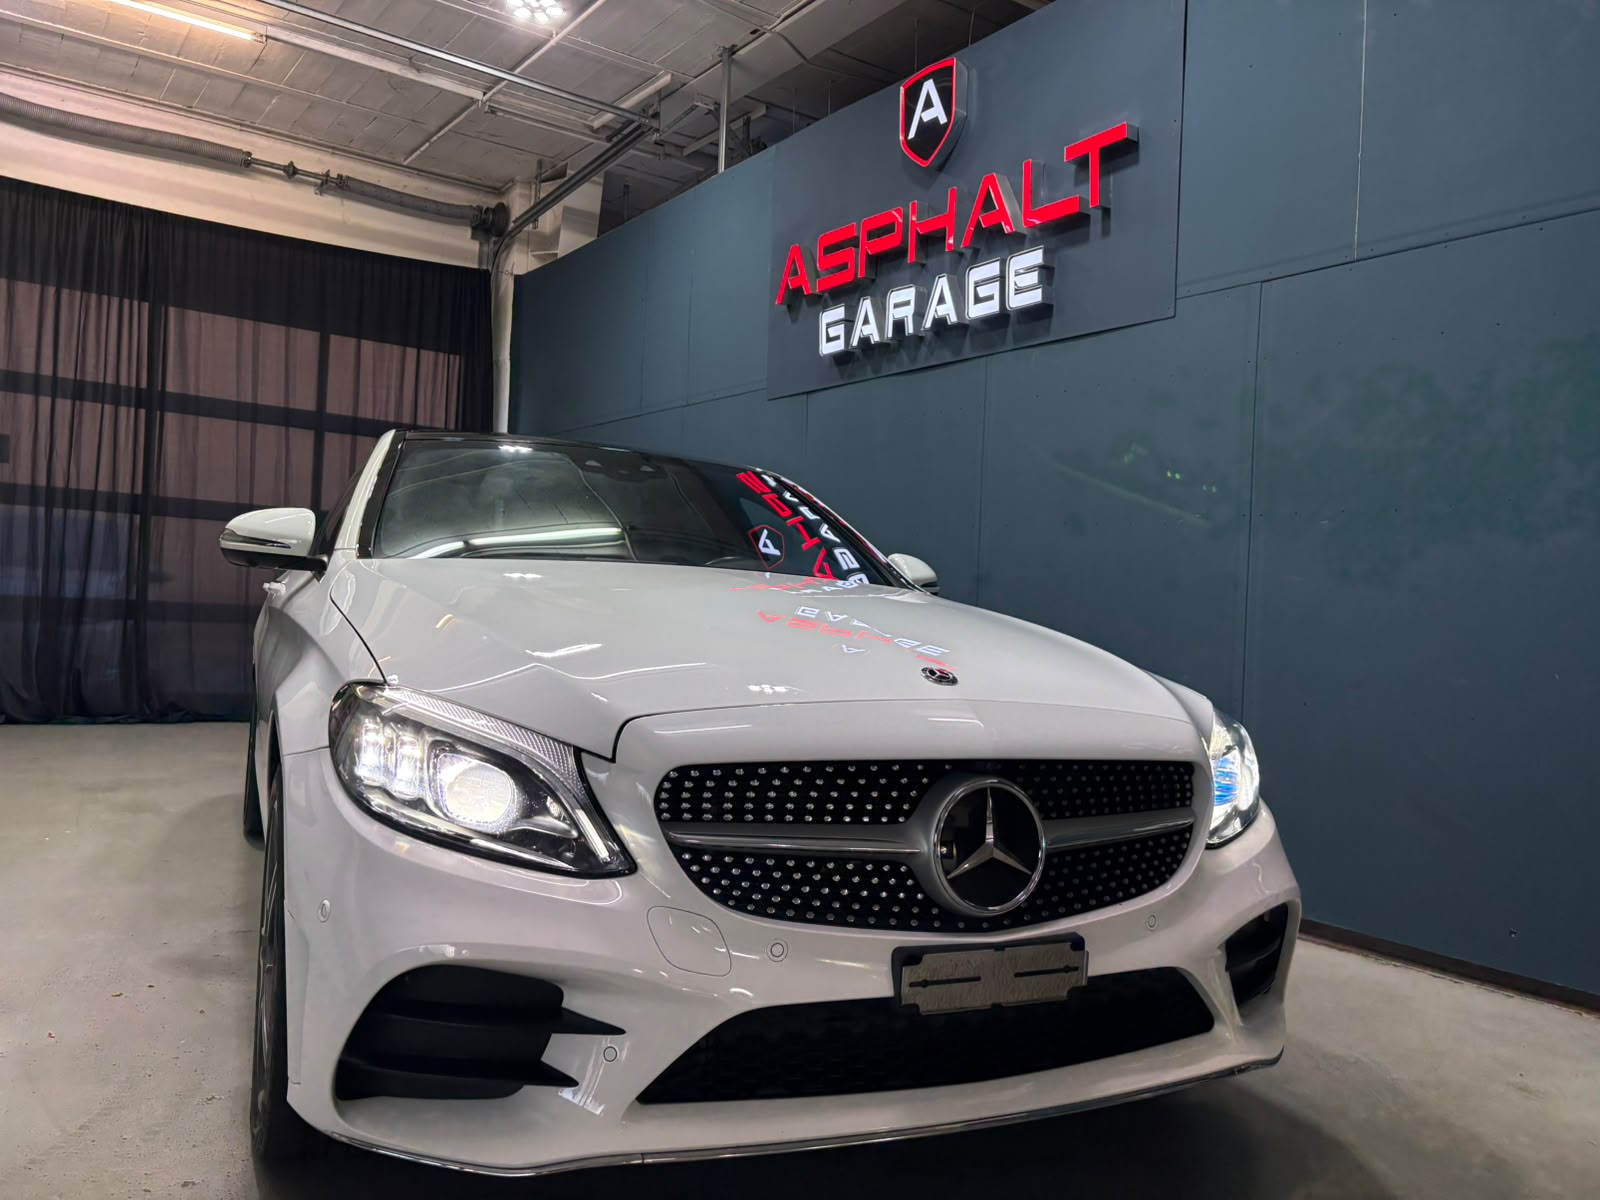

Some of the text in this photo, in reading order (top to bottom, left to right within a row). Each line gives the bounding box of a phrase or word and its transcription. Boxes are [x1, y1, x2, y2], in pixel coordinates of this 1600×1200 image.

[907, 78, 948, 140] A
[775, 121, 1128, 305] ASPHALT
[818, 245, 1045, 357] GARAGE
